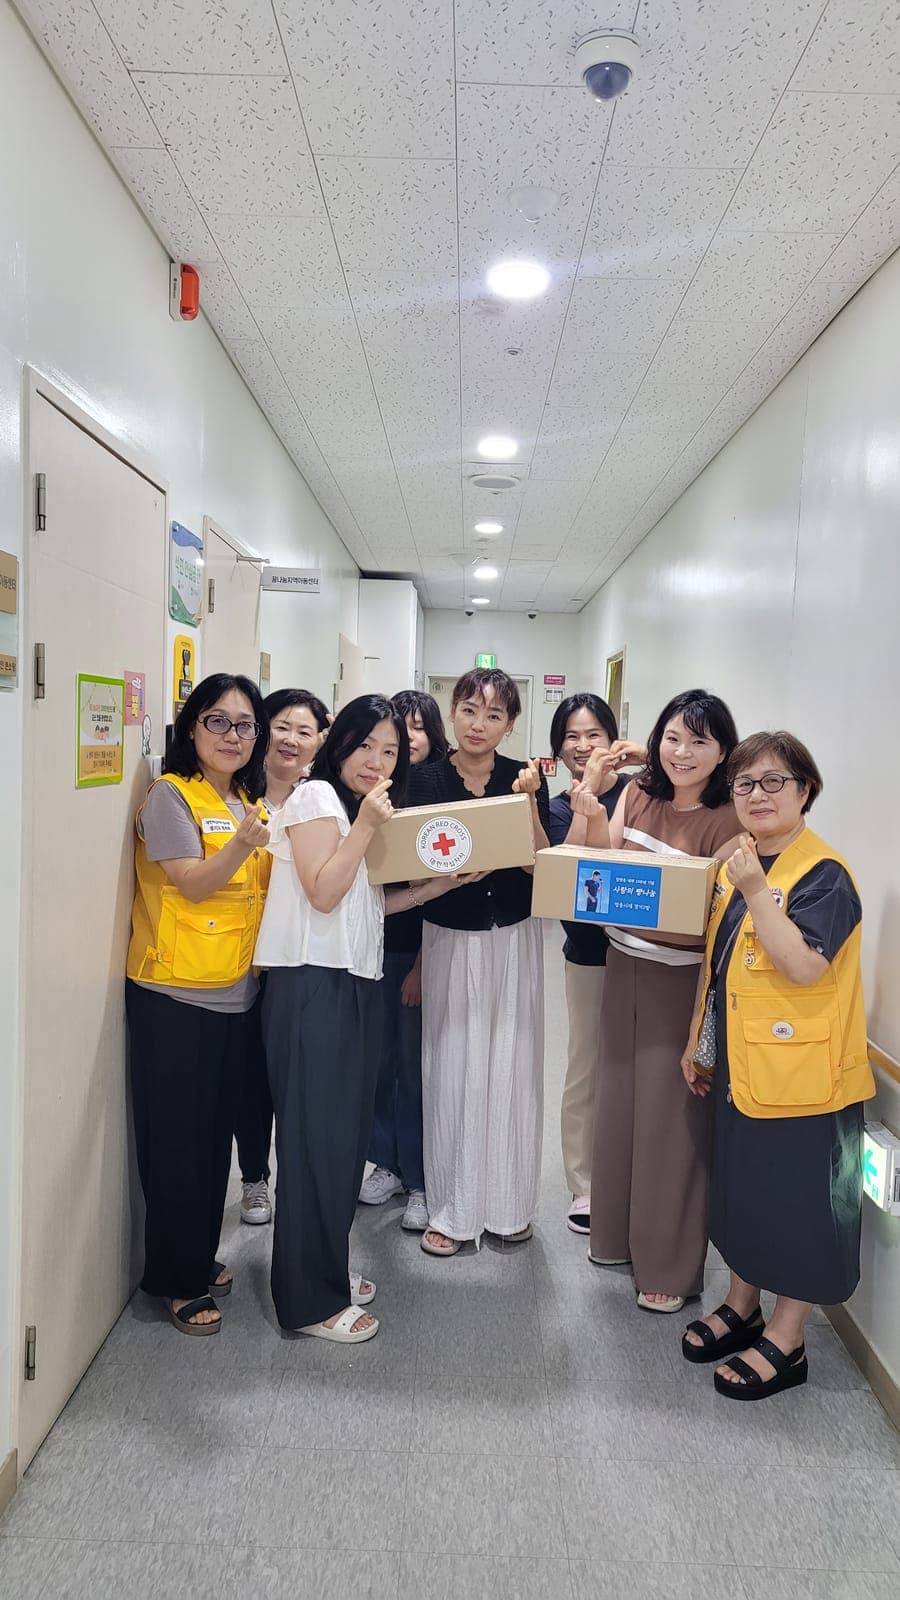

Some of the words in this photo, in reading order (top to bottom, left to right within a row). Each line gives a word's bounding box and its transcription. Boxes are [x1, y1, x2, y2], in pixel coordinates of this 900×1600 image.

[420, 824, 436, 850] KOREAN
[435, 820, 449, 828] RED
[449, 822, 467, 841] CROSS
[613, 885, 634, 895] 사랑의
[635, 887, 657, 898] 빵나눔
